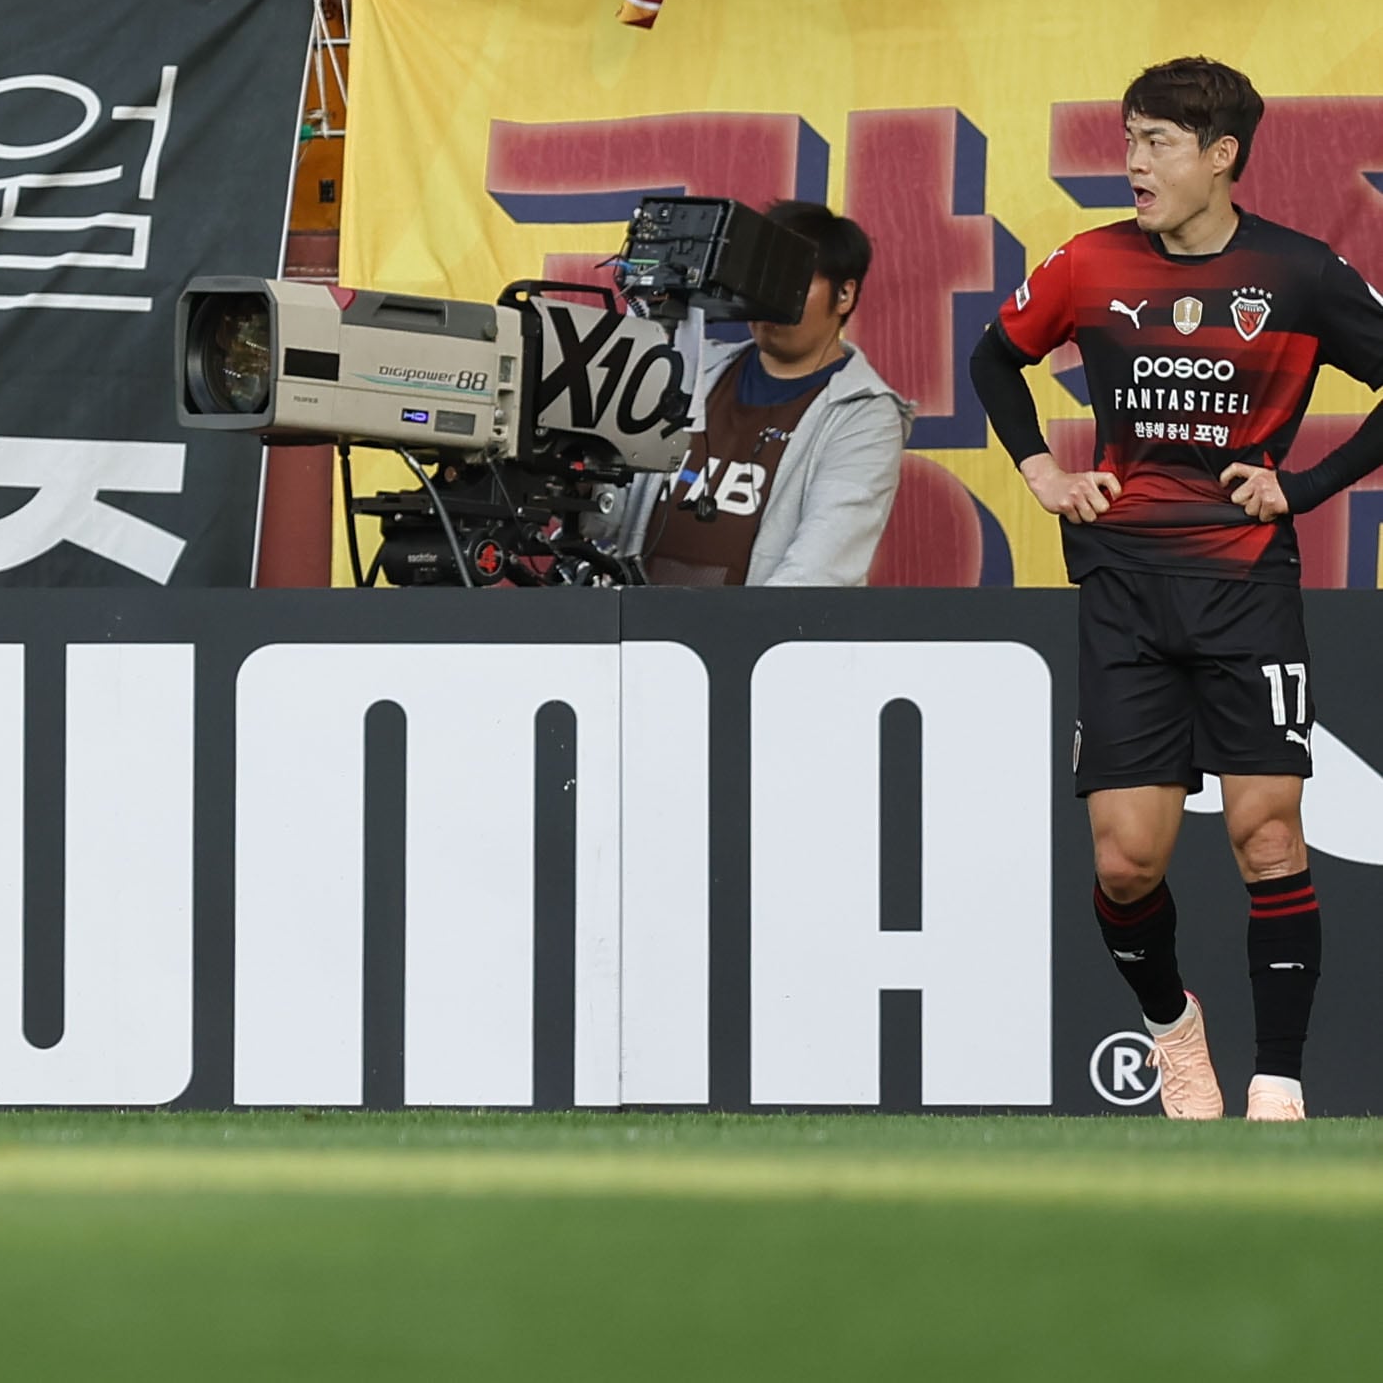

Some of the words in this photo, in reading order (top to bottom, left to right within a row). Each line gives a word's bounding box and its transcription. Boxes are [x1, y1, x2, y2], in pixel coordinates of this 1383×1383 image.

[455, 369, 488, 393] 88
[1132, 354, 1236, 385] posco
[1113, 387, 1251, 416] FANTASTEEL
[1166, 423, 1190, 441] 중심
[1193, 424, 1230, 448] 포항
[1261, 663, 1307, 726] 17
